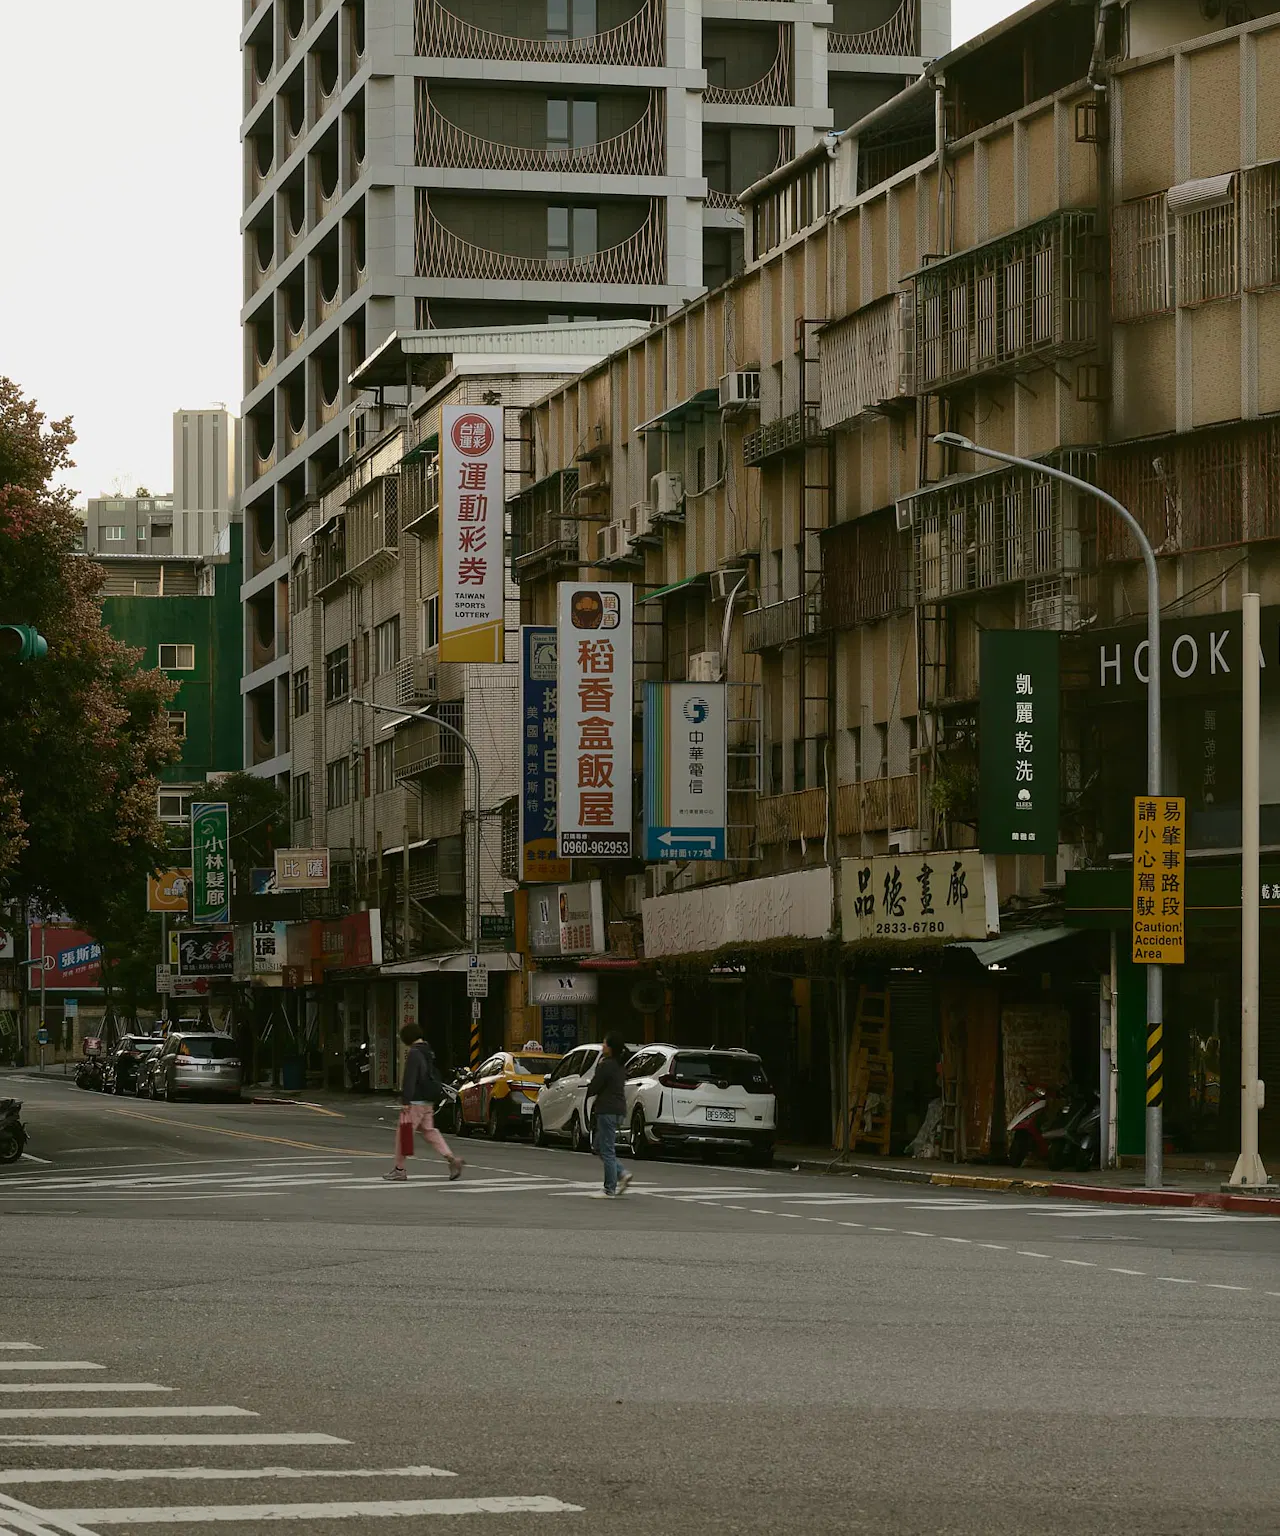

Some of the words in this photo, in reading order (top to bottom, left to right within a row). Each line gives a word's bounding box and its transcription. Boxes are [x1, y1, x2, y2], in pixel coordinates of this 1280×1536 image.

[460, 422, 486, 435] 台灣
[460, 435, 487, 449] 運彩
[457, 462, 488, 586] 運動彩券
[455, 611, 490, 619] LOTTERY
[577, 638, 615, 827] 稻香盒飯屋
[1015, 672, 1034, 782] 凱麗乾洗
[526, 705, 539, 813] 美國戴克斯特
[688, 730, 704, 795] 中華電信
[563, 840, 629, 855] 0960-962953
[660, 848, 713, 858] 斜對面177號
[1137, 801, 1157, 916] 請小心駕駛
[1161, 801, 1181, 916] 易肇事路段
[204, 836, 225, 906] 小林髮廊
[282, 859, 324, 879] 比薩
[853, 860, 968, 918] 品德畫廊
[876, 921, 945, 935] 2833-6780
[1134, 921, 1183, 933] Caution!
[1134, 935, 1183, 946] Accident
[1134, 948, 1162, 959] Area
